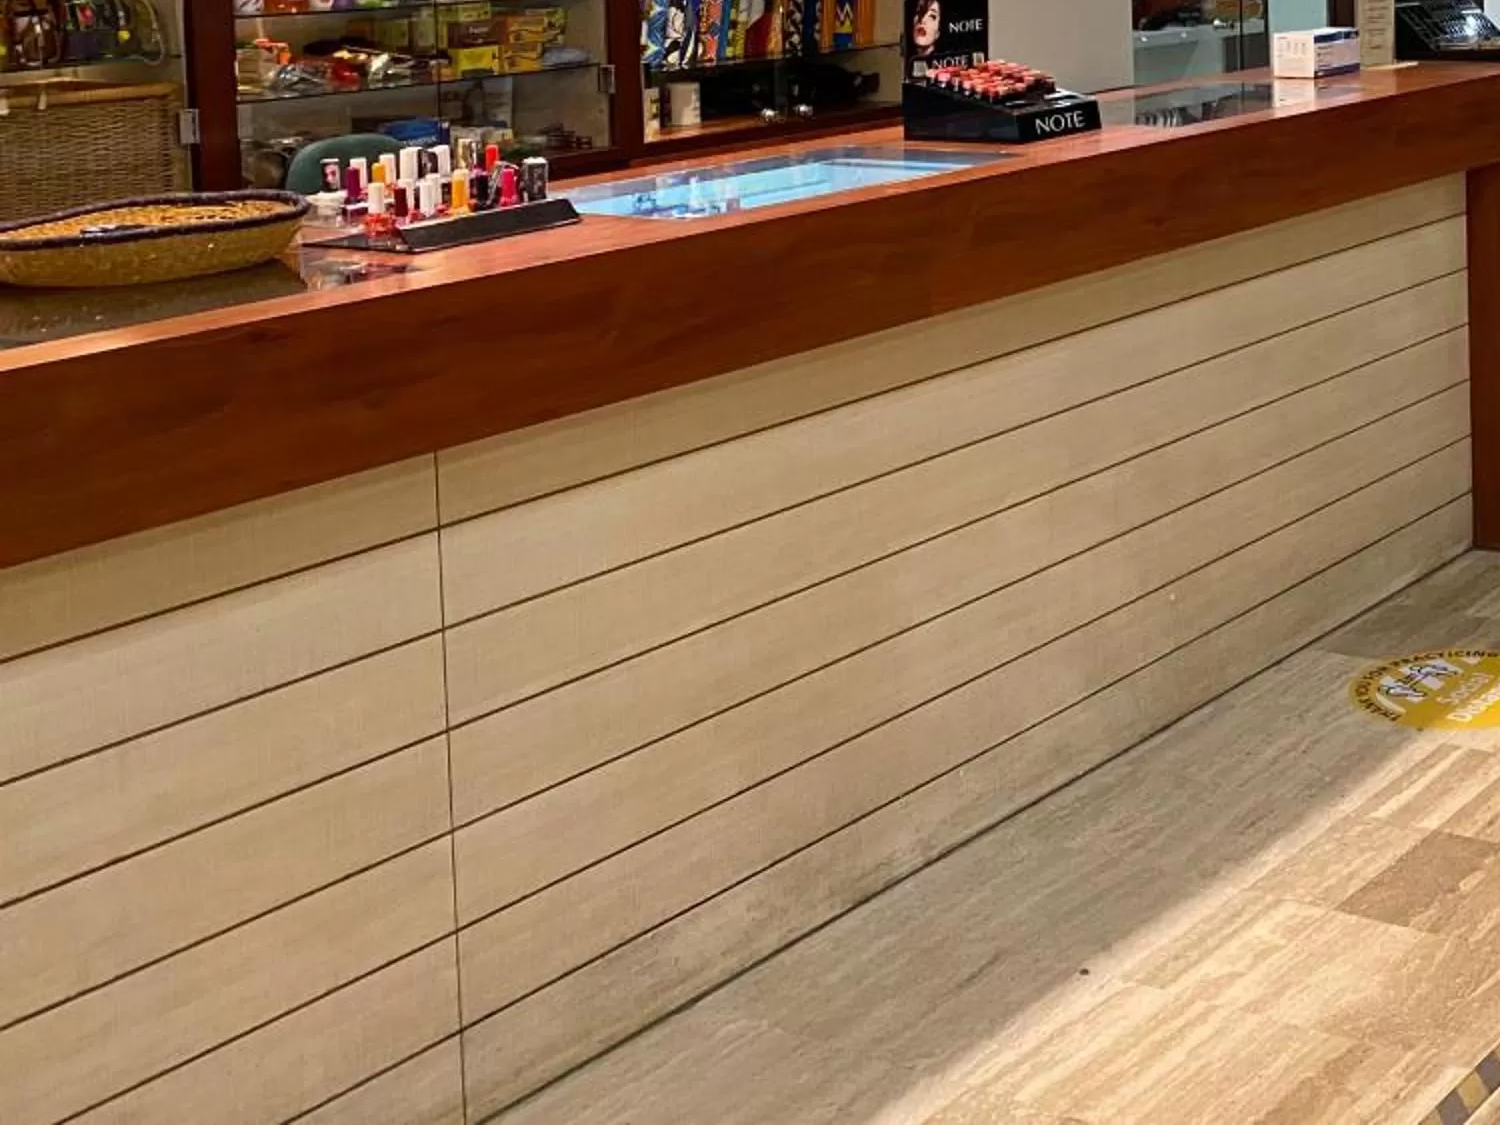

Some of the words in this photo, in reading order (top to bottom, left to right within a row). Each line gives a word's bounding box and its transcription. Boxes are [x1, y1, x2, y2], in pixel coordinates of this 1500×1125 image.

[949, 18, 984, 34] NOTE
[932, 54, 969, 70] NOTE
[1035, 110, 1087, 135] NOTE
